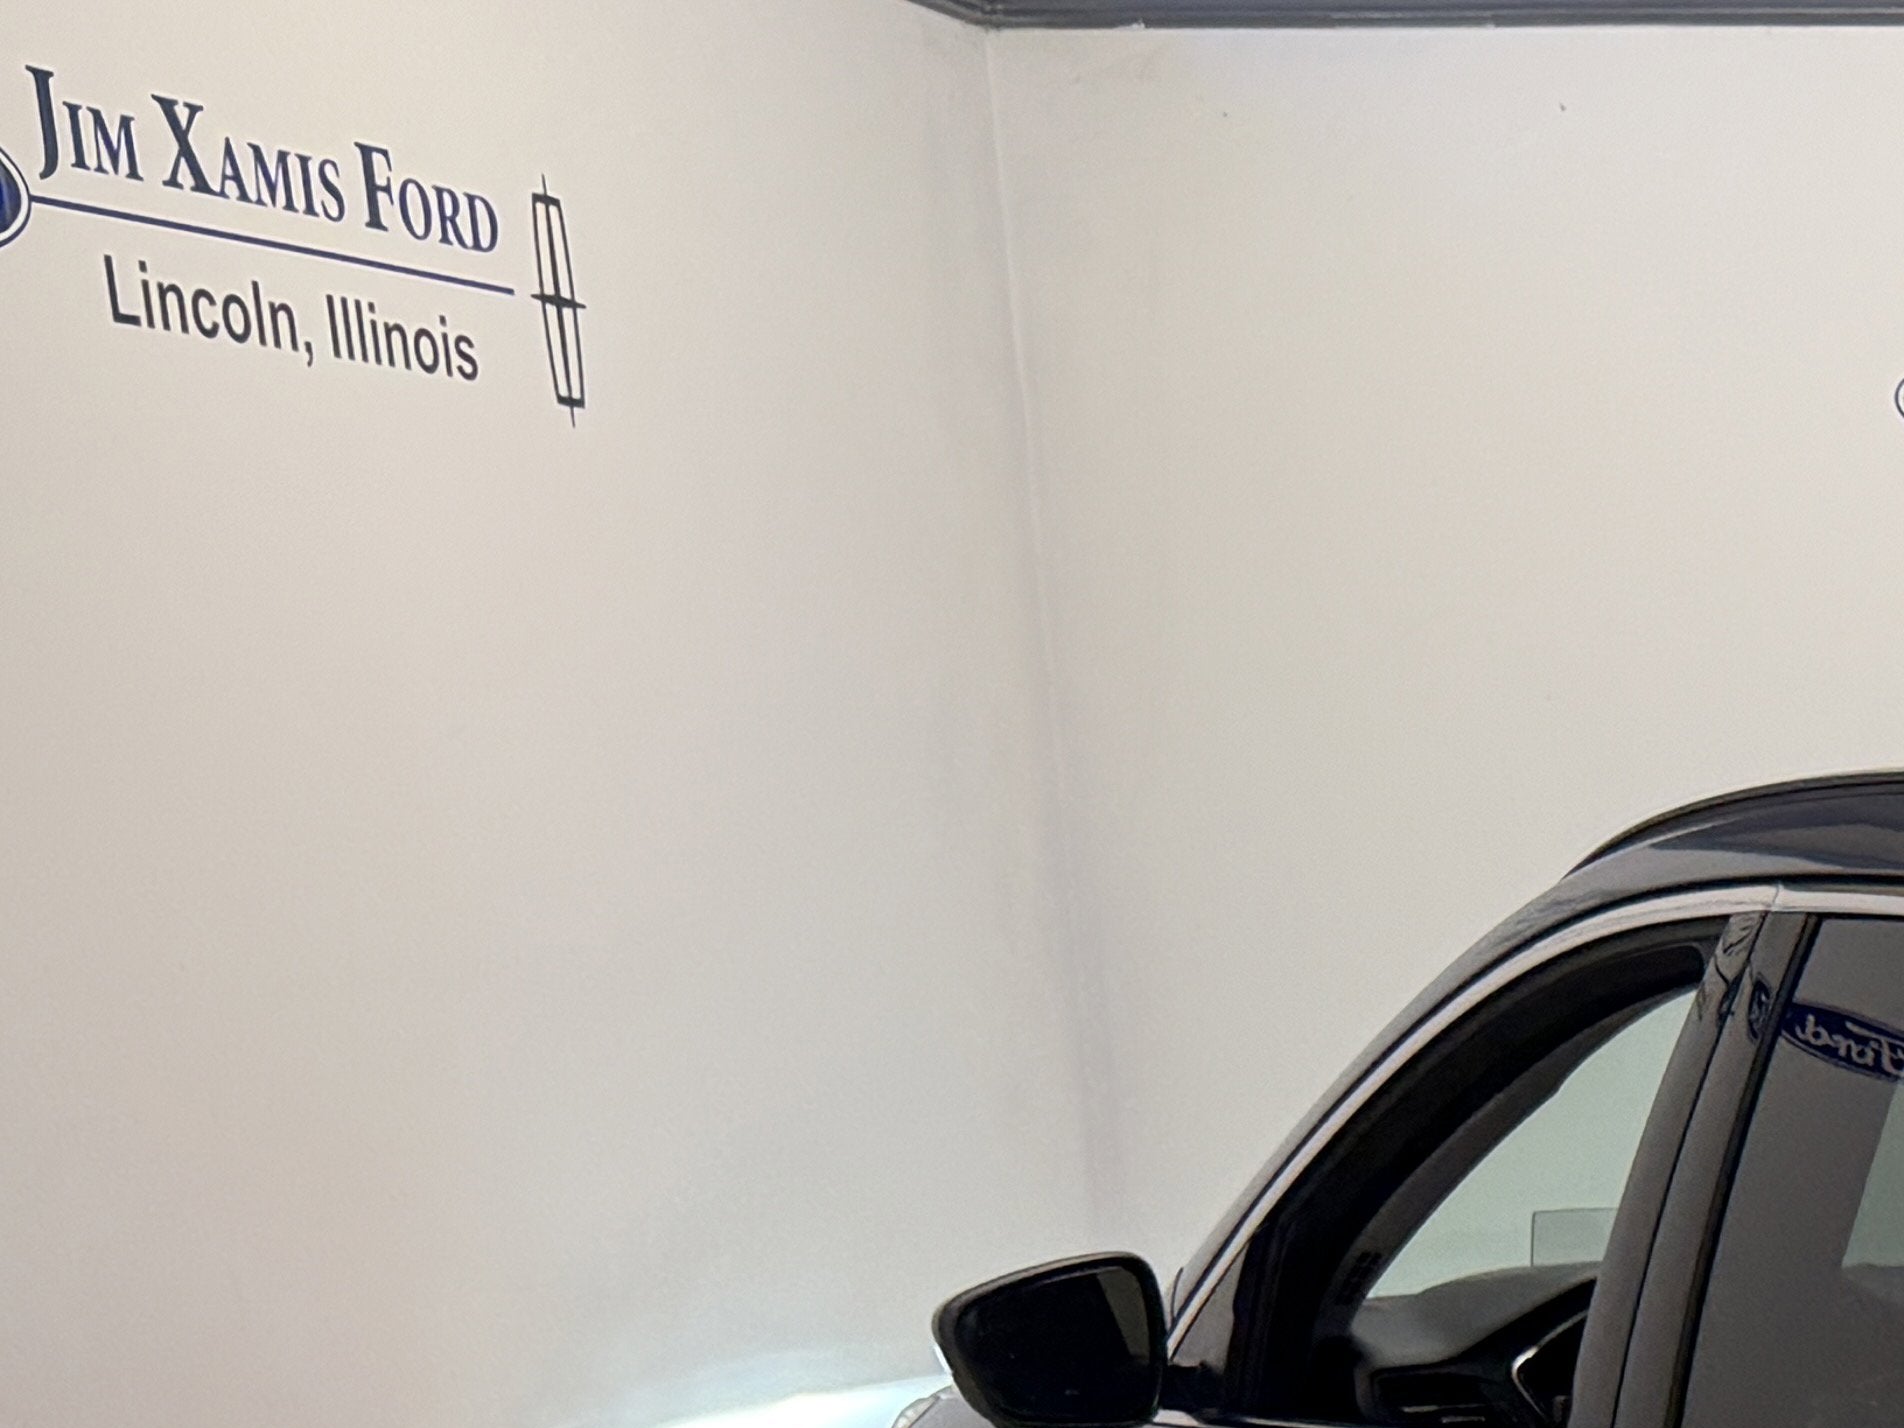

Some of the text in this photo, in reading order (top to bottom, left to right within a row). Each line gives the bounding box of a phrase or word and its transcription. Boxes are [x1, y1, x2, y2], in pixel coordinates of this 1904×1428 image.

[25, 64, 498, 253] JIM XAMIS FORD
[104, 253, 479, 381] Lincoln, Illinois
